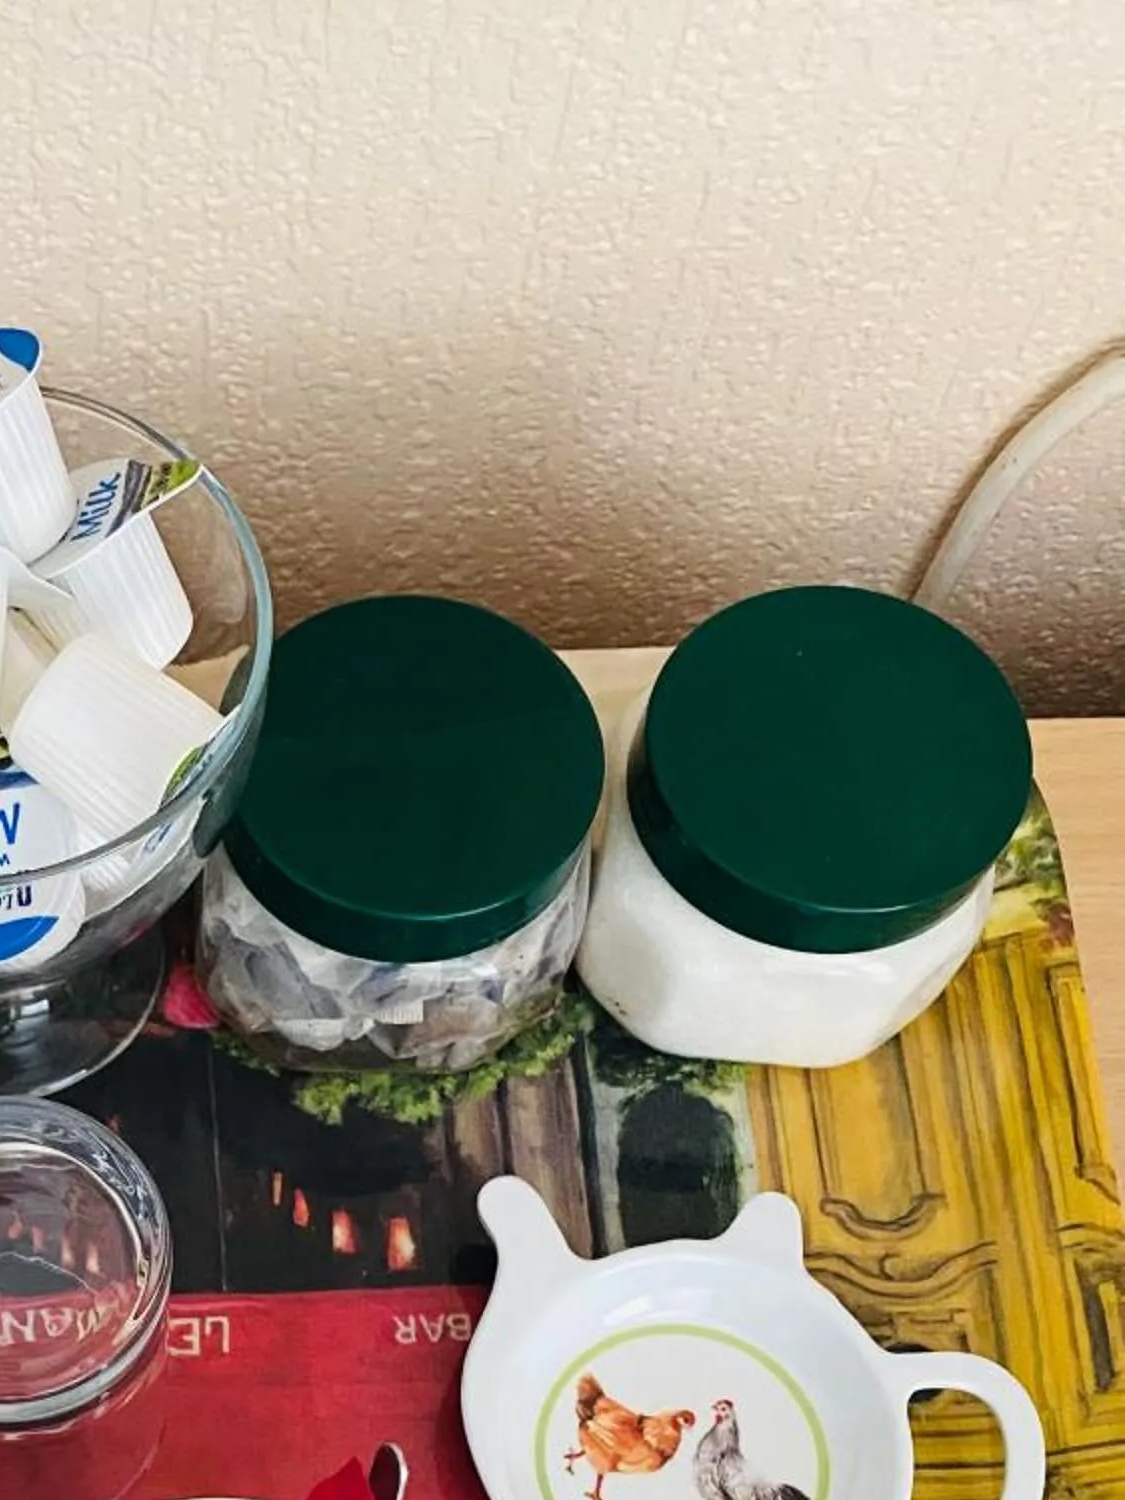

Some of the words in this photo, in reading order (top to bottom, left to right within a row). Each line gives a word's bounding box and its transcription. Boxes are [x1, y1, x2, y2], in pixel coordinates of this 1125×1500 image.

[70, 472, 121, 542] Milk
[164, 1313, 230, 1358] LE
[390, 1309, 471, 1346] BAR
